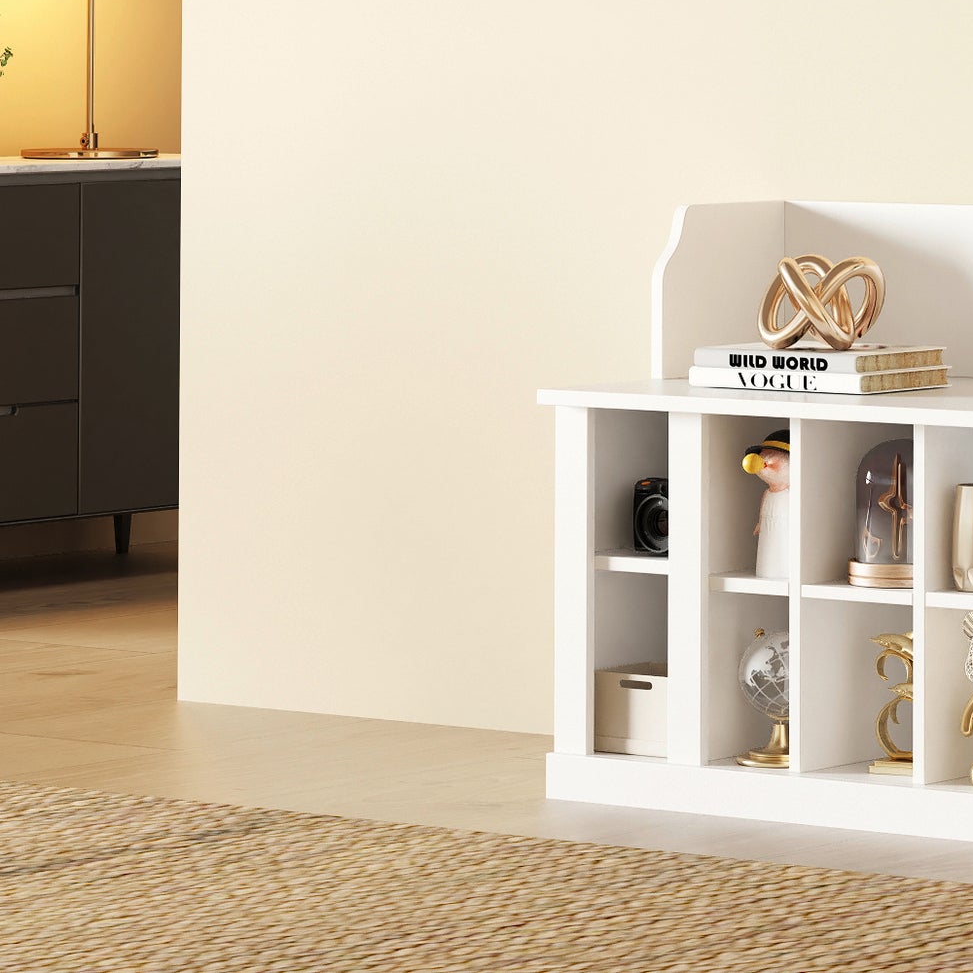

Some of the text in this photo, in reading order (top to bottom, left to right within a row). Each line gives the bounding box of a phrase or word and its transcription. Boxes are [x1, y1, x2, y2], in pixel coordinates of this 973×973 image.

[729, 353, 829, 372] WILD WORLD
[738, 372, 817, 390] VOGUE
